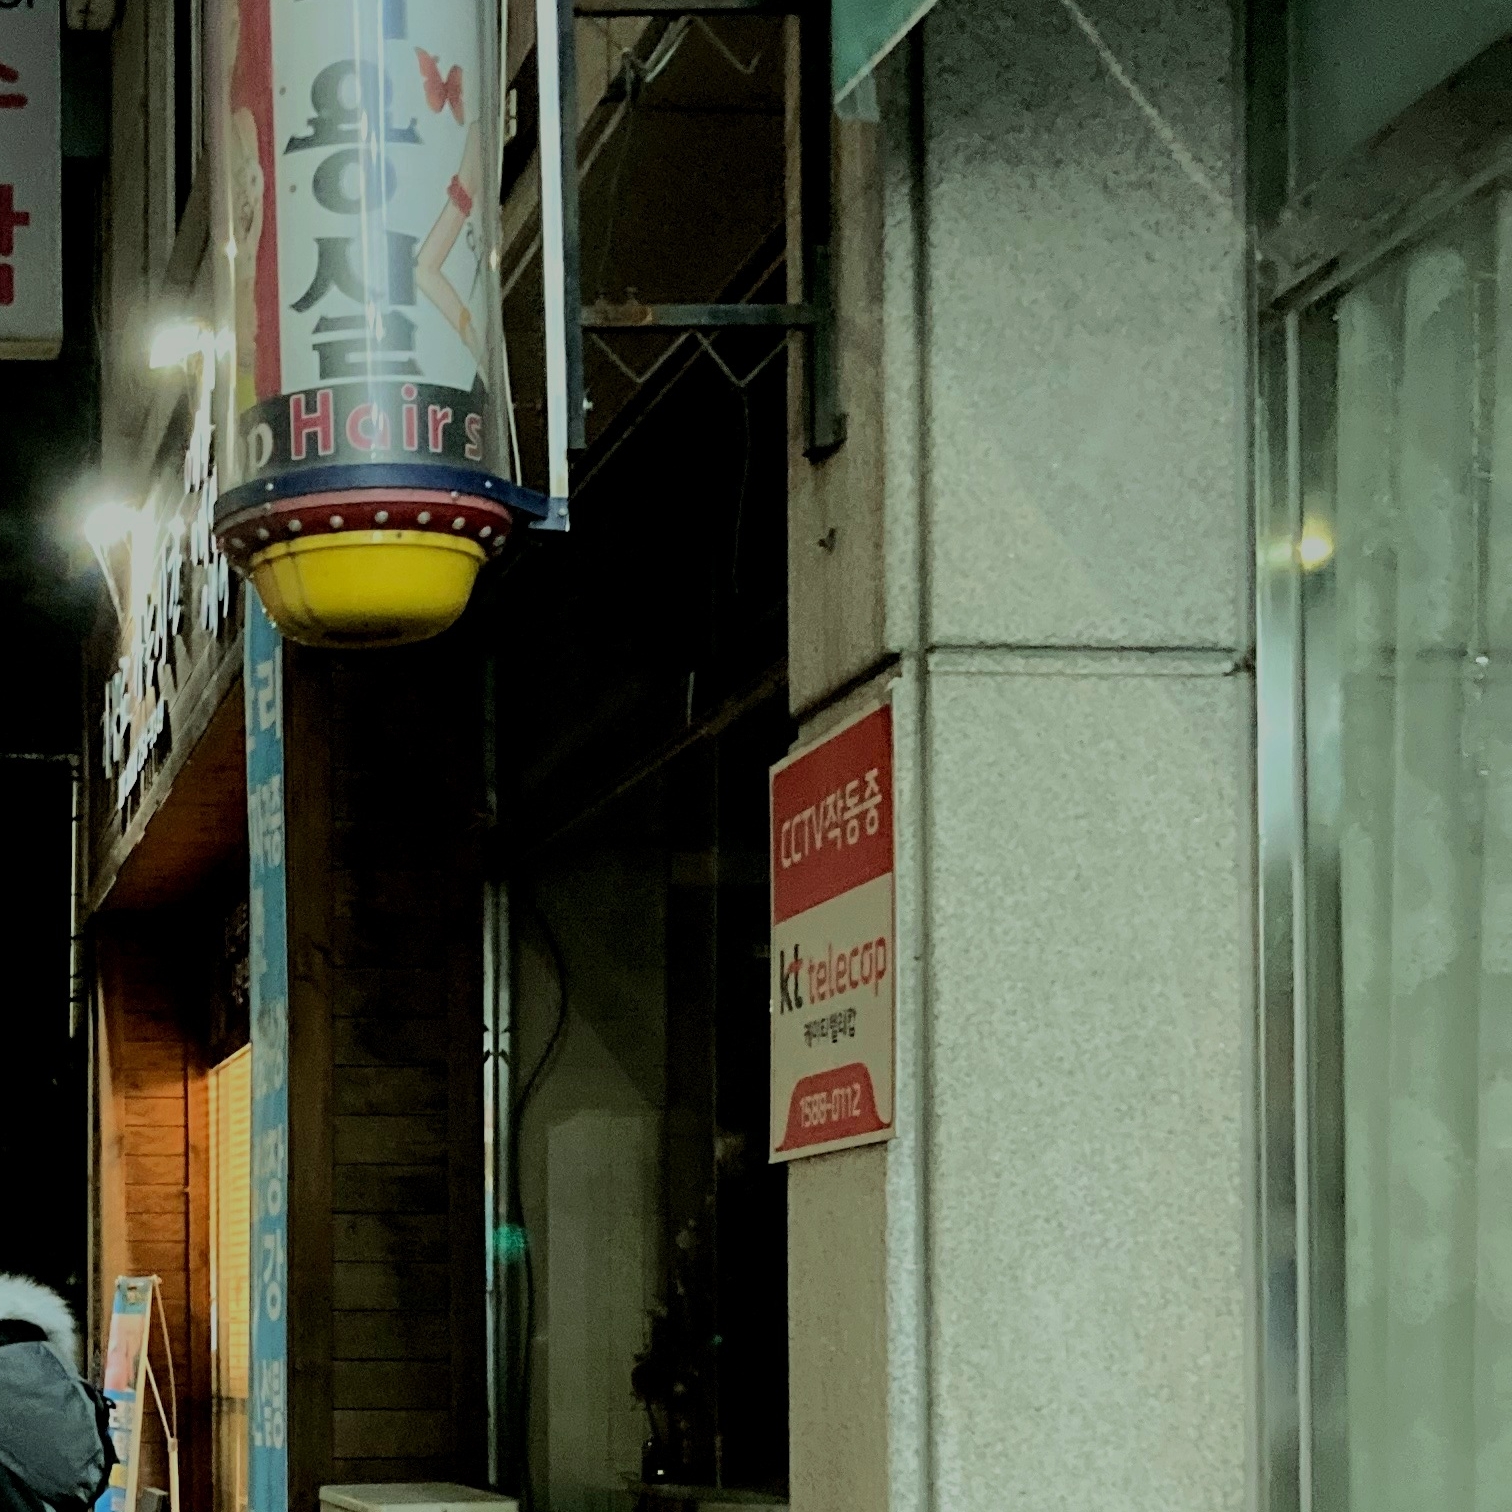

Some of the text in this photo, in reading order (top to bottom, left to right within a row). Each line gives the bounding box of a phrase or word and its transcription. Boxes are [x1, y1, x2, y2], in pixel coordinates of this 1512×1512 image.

[284, 0, 424, 381] 용실
[780, 936, 888, 1015] kt telecop
